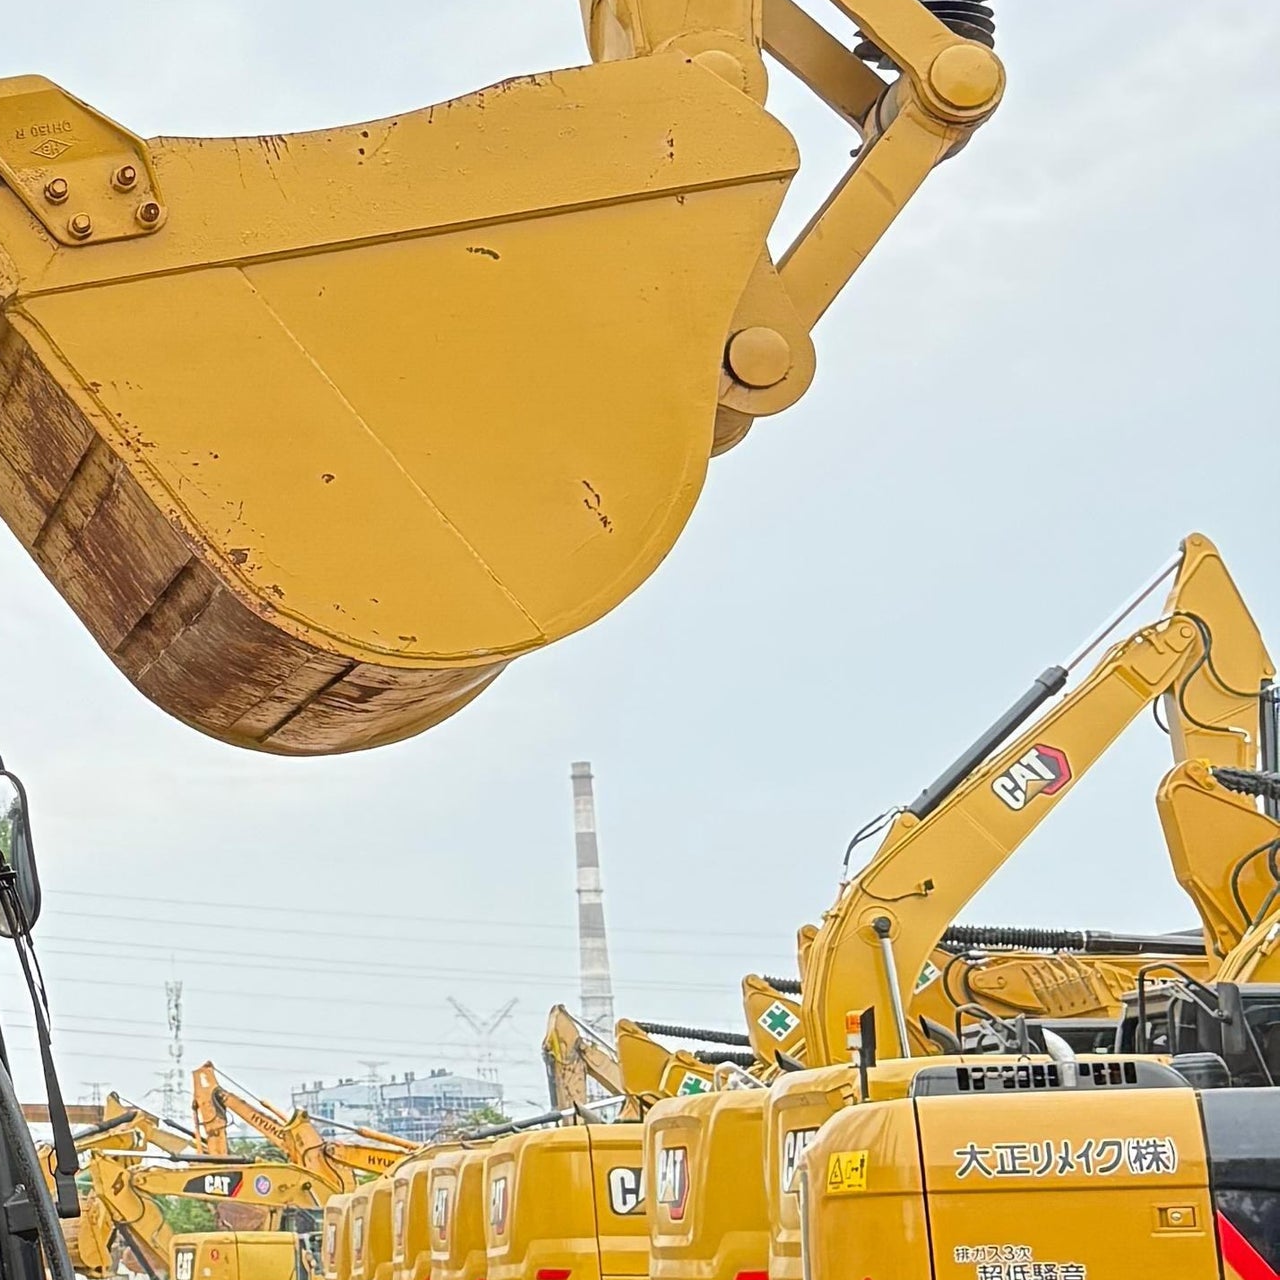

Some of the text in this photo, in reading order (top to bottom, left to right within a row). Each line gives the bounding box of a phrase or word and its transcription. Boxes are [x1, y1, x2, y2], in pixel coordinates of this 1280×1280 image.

[992, 747, 1056, 811] CAT
[204, 1175, 230, 1195] CAT
[658, 1149, 684, 1202] CAT
[955, 1245, 1032, 1263] 排ガス3次
